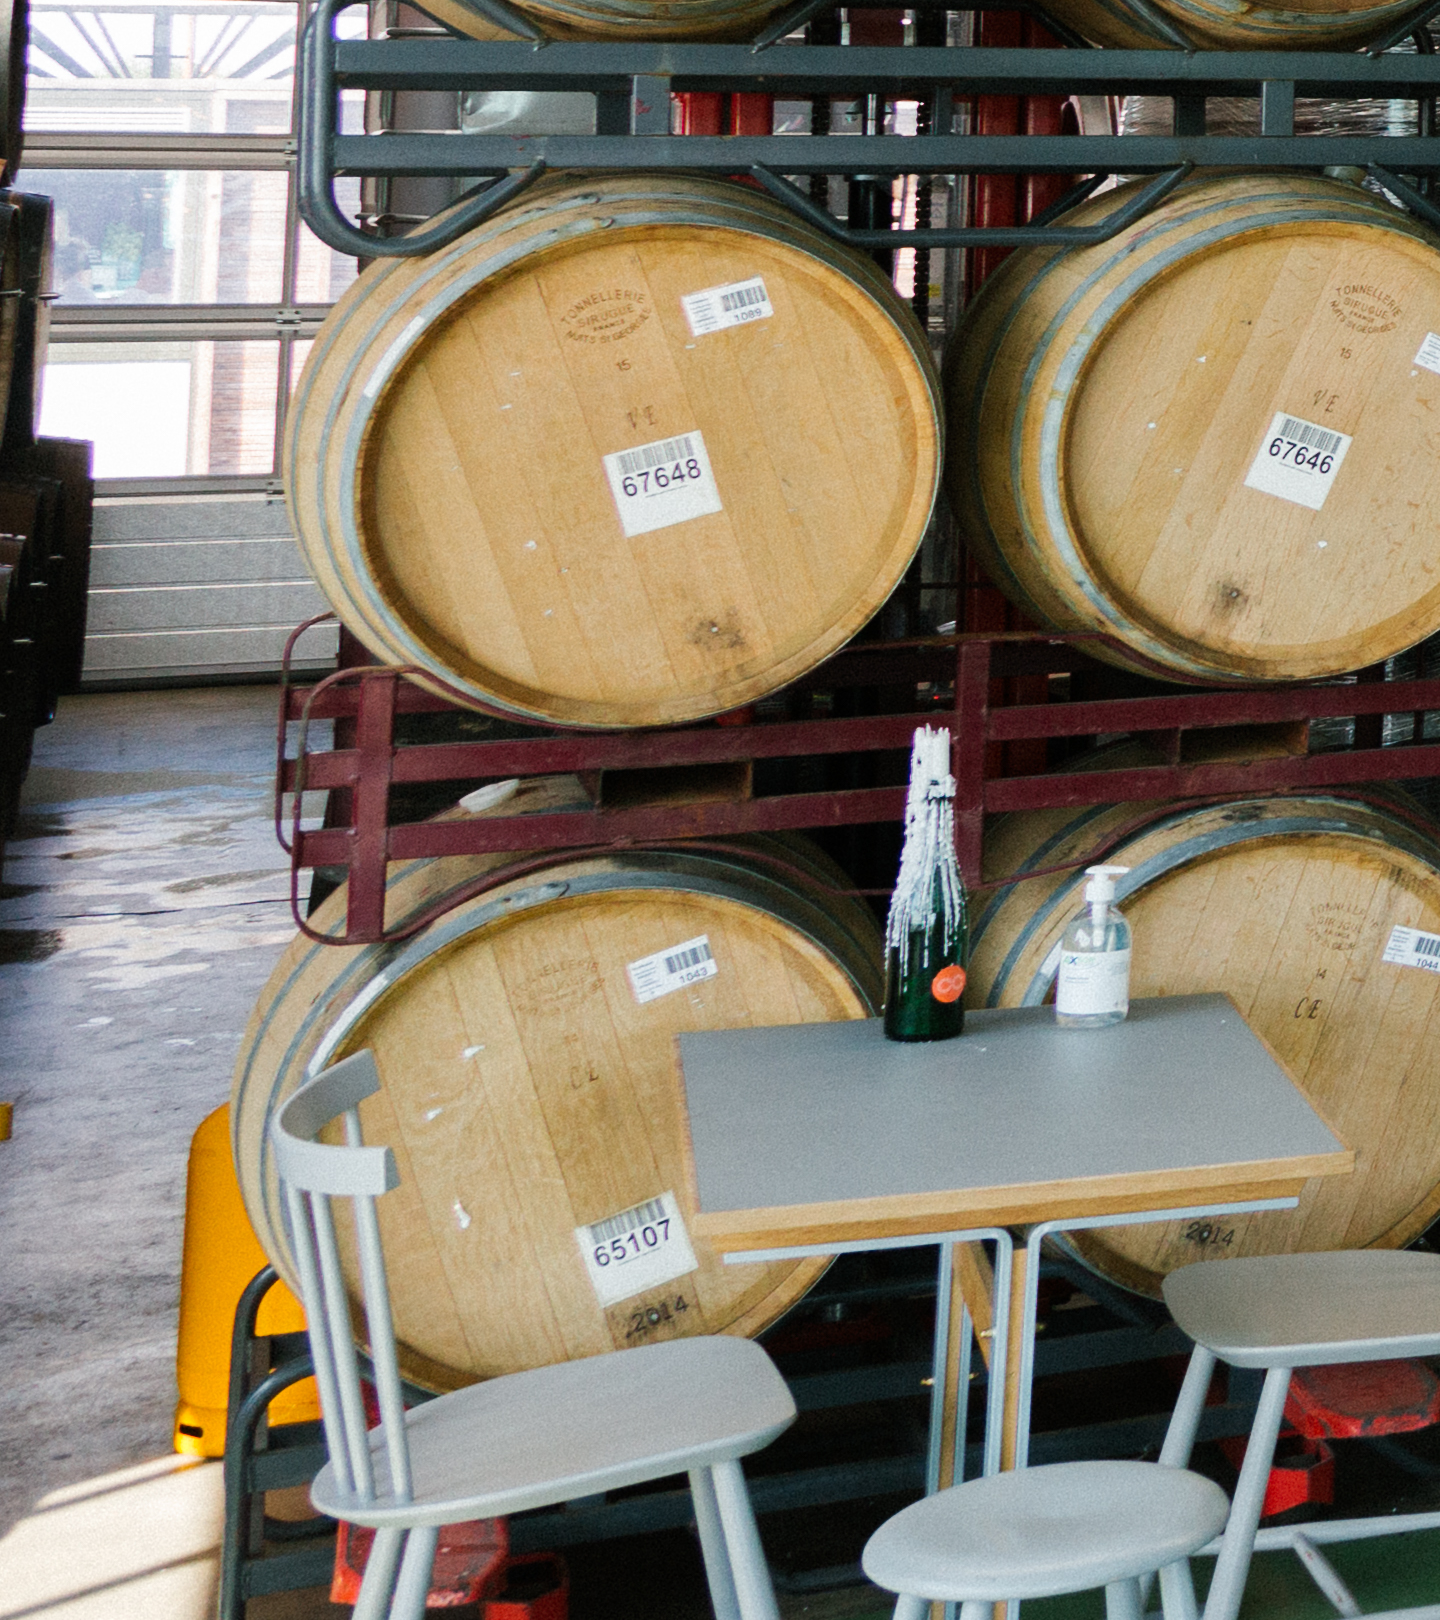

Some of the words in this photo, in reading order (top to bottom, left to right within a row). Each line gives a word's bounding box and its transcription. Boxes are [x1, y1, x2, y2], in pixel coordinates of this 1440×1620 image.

[734, 308, 762, 322] 1089
[1268, 437, 1334, 474] 67646
[622, 459, 702, 497] 67648
[680, 967, 708, 983] 1043
[1416, 958, 1439, 970] 1044
[594, 1218, 670, 1267] 65107
[1184, 1221, 1233, 1247] 2014
[626, 1294, 688, 1338] 2014
